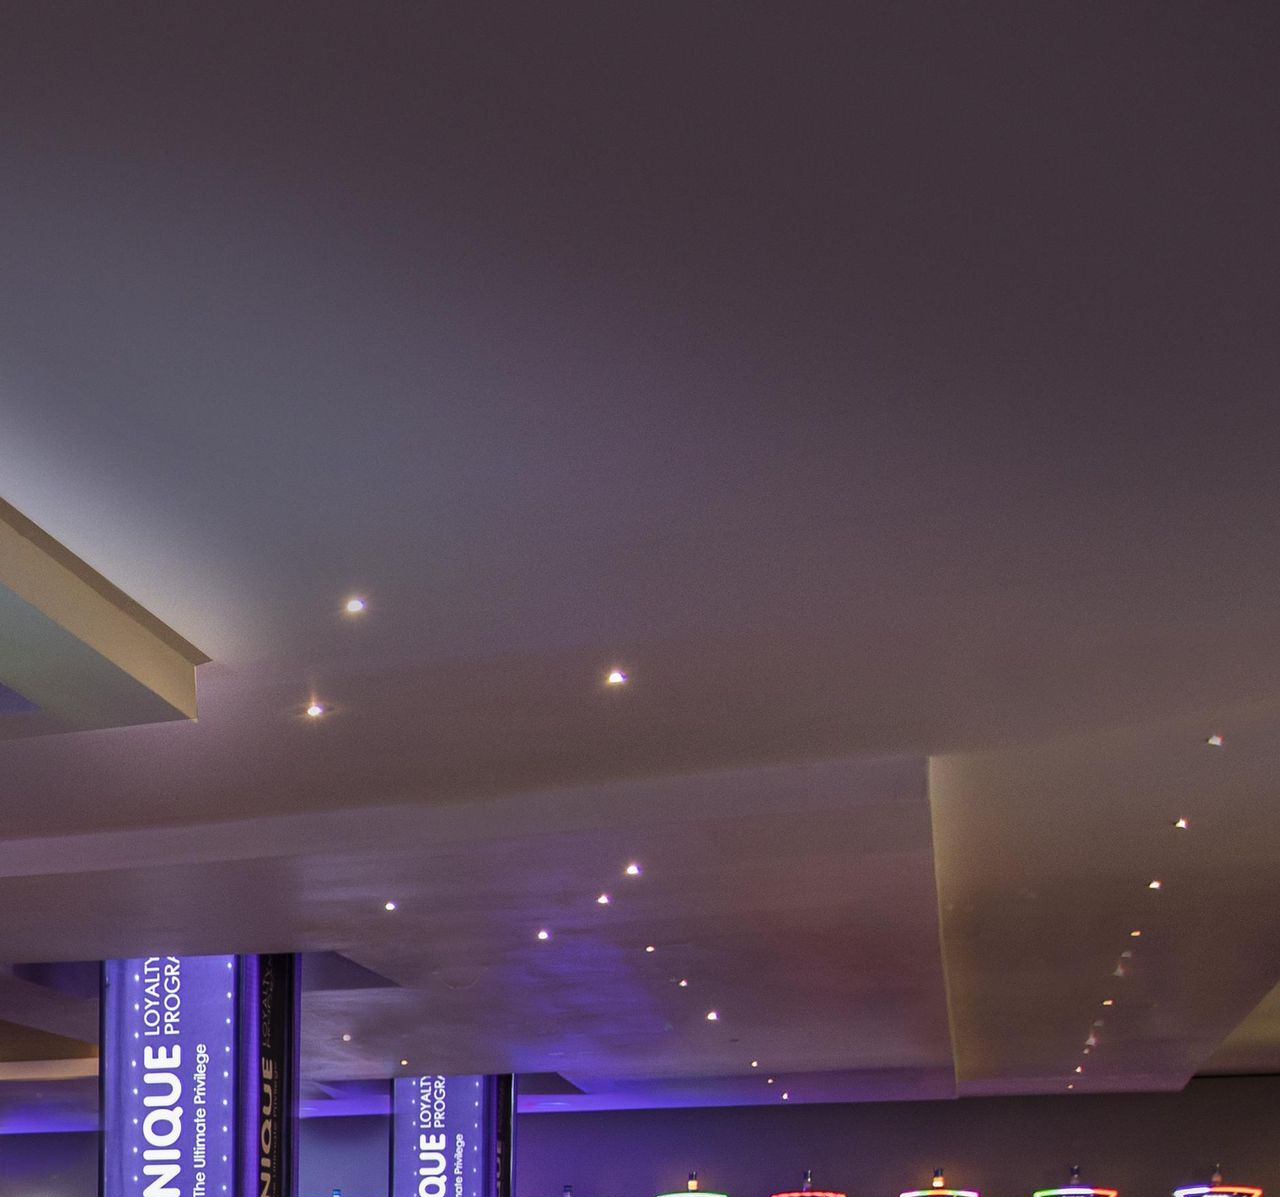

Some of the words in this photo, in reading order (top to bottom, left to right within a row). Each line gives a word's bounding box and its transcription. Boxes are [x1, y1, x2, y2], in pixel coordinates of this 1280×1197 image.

[144, 957, 160, 1036] LOYALTY
[193, 1044, 209, 1104] Privilege
[193, 1107, 207, 1167] Ultimate
[453, 1133, 465, 1173] Privilege
[193, 1170, 206, 1197] The
